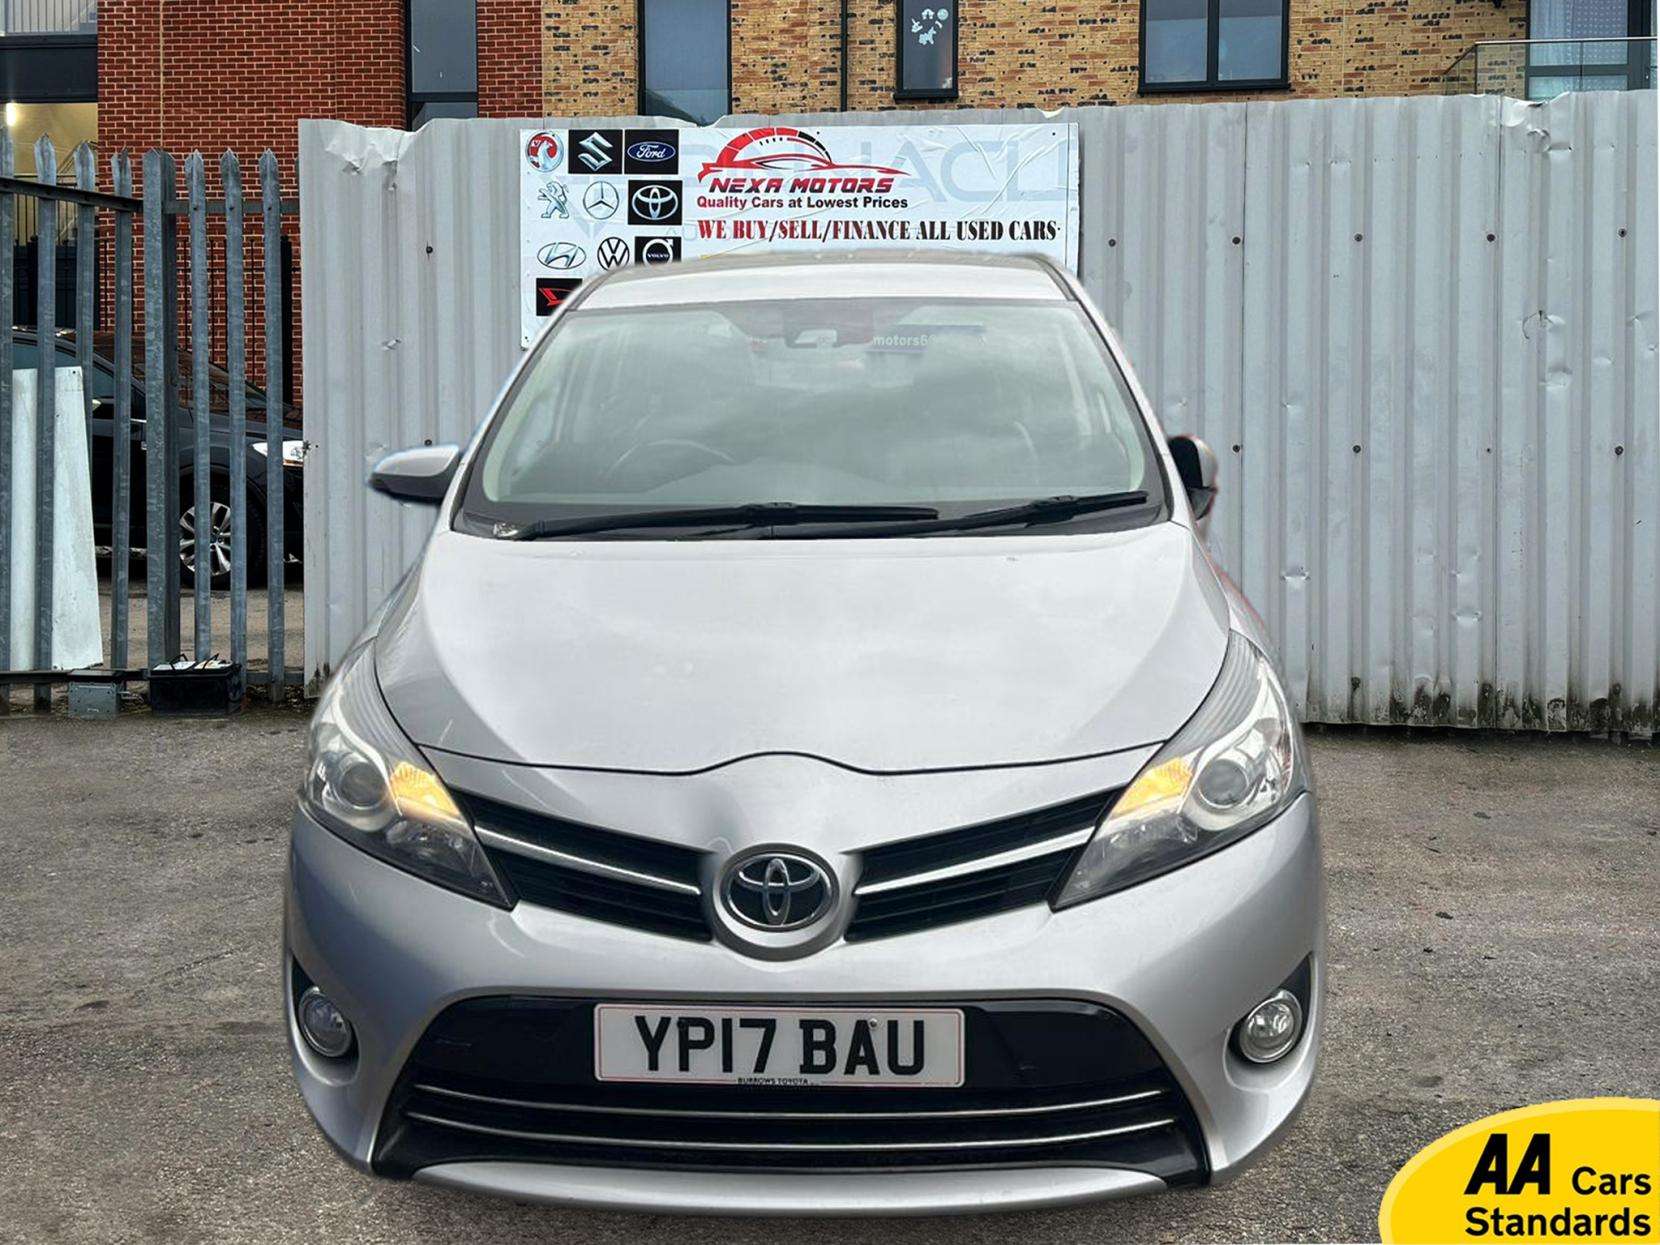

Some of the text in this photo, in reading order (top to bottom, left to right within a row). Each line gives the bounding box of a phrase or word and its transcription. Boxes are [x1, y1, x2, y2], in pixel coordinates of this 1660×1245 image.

[636, 144, 666, 159] Ford
[709, 177, 895, 194] NEXA MOTORS
[697, 196, 909, 209] Quality Cars at Lowest Prices
[697, 220, 727, 240] WE
[733, 219, 911, 242] BUY/SELL/FINANCE
[916, 221, 951, 240] ALL
[956, 221, 1004, 240] USED
[1008, 221, 1057, 240] CARS
[634, 1015, 925, 1076] YP17 BAU
[738, 1077, 776, 1085] BURROWS
